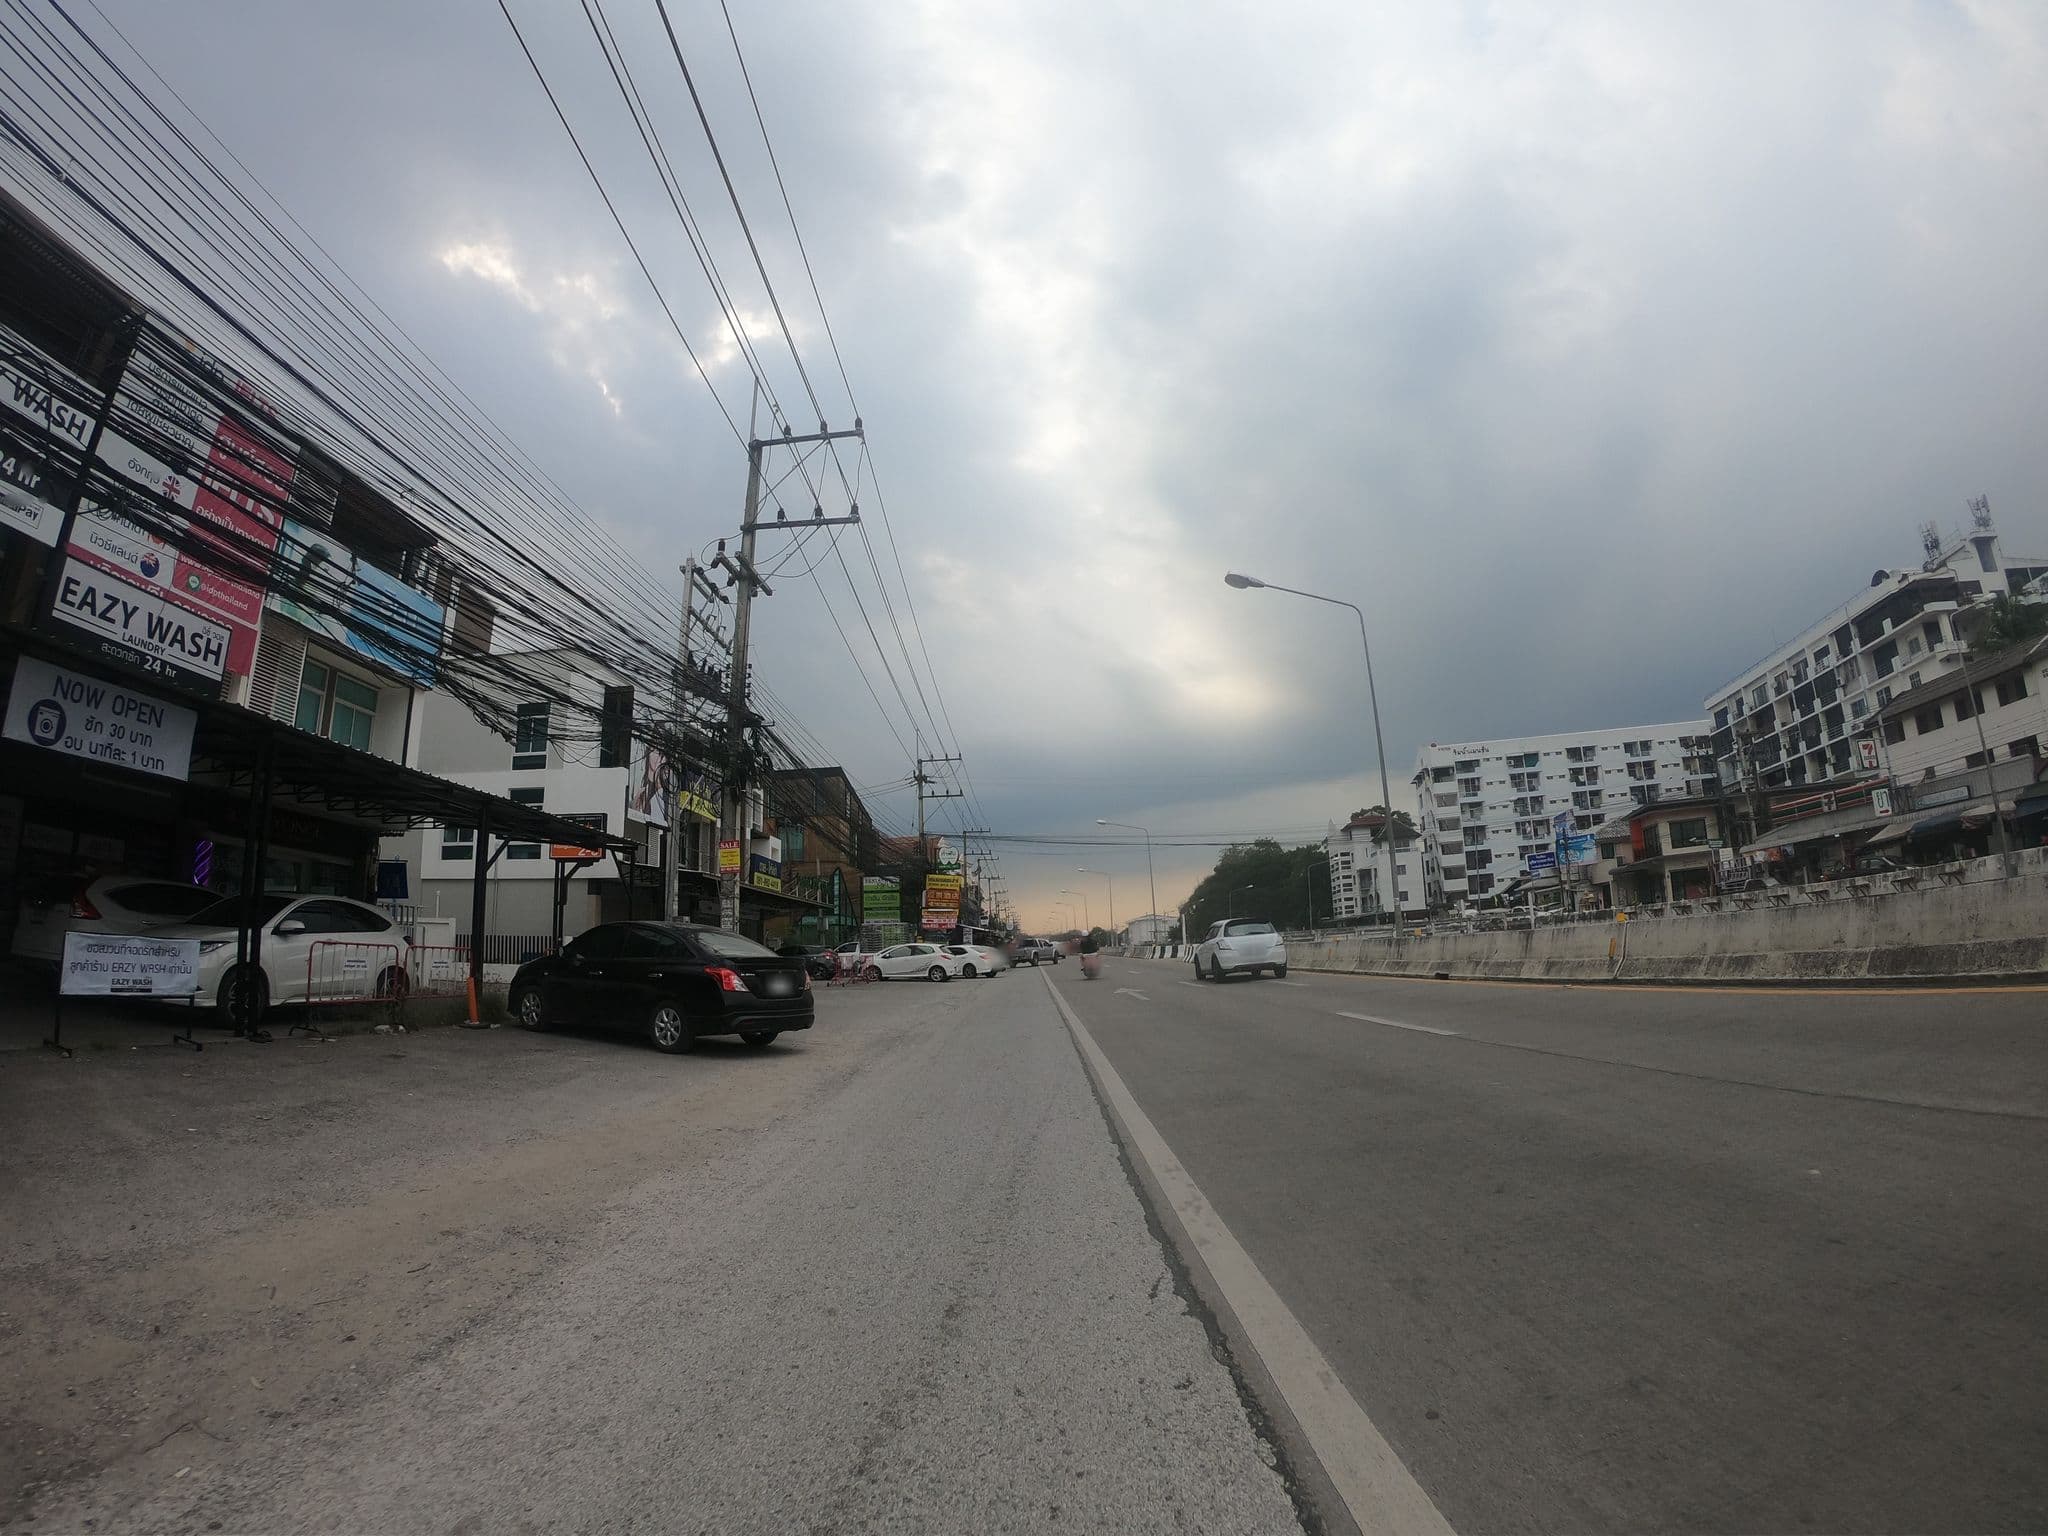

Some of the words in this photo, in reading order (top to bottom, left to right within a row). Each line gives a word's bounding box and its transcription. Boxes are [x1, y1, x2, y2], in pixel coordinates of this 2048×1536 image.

[14, 374, 86, 443] WASH
[200, 583, 249, 610] @idpthailand
[60, 576, 139, 629] EAZY
[146, 612, 224, 666] WASH
[101, 641, 140, 665] สะดวกซัก
[143, 655, 161, 674] 24
[165, 664, 177, 678] hr
[122, 631, 166, 656] LAUNDRY
[52, 675, 106, 710] NOW
[112, 695, 164, 728] OPEN
[85, 716, 103, 734] ซัก
[109, 723, 125, 740] 30
[129, 731, 153, 748] บาท
[64, 736, 83, 751] อบ
[131, 751, 137, 764] 1
[141, 754, 165, 771] บาท
[720, 841, 739, 849] SALE
[112, 962, 136, 973] EAZY
[140, 963, 166, 974] WASH
